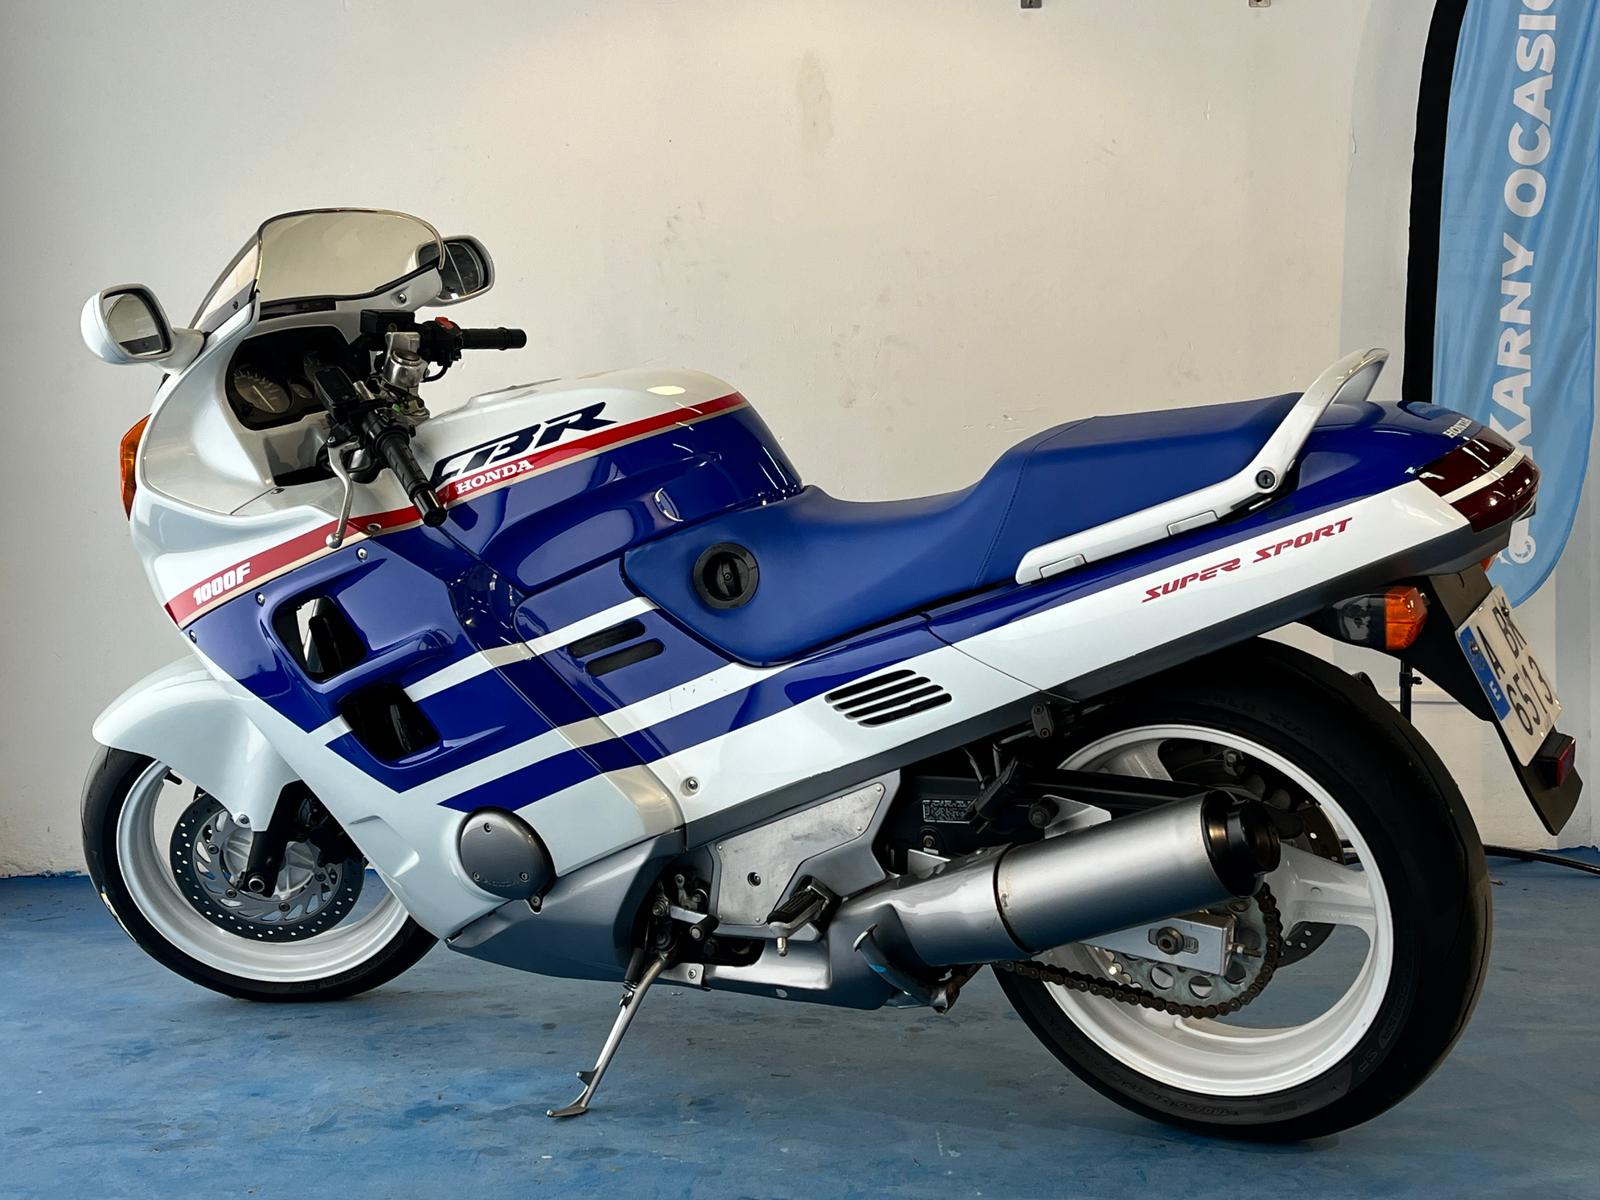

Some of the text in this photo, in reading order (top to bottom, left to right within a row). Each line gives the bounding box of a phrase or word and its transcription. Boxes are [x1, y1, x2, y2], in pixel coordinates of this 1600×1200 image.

[1504, 0, 1556, 218] OCASI
[430, 401, 618, 487] CBR
[1442, 416, 1473, 439] HONDA
[455, 460, 535, 495] HONDA
[193, 561, 251, 606] 1000F
[1142, 517, 1353, 603] SUPER SPORT
[1476, 625, 1505, 680] A
[1506, 655, 1553, 736] 6513
